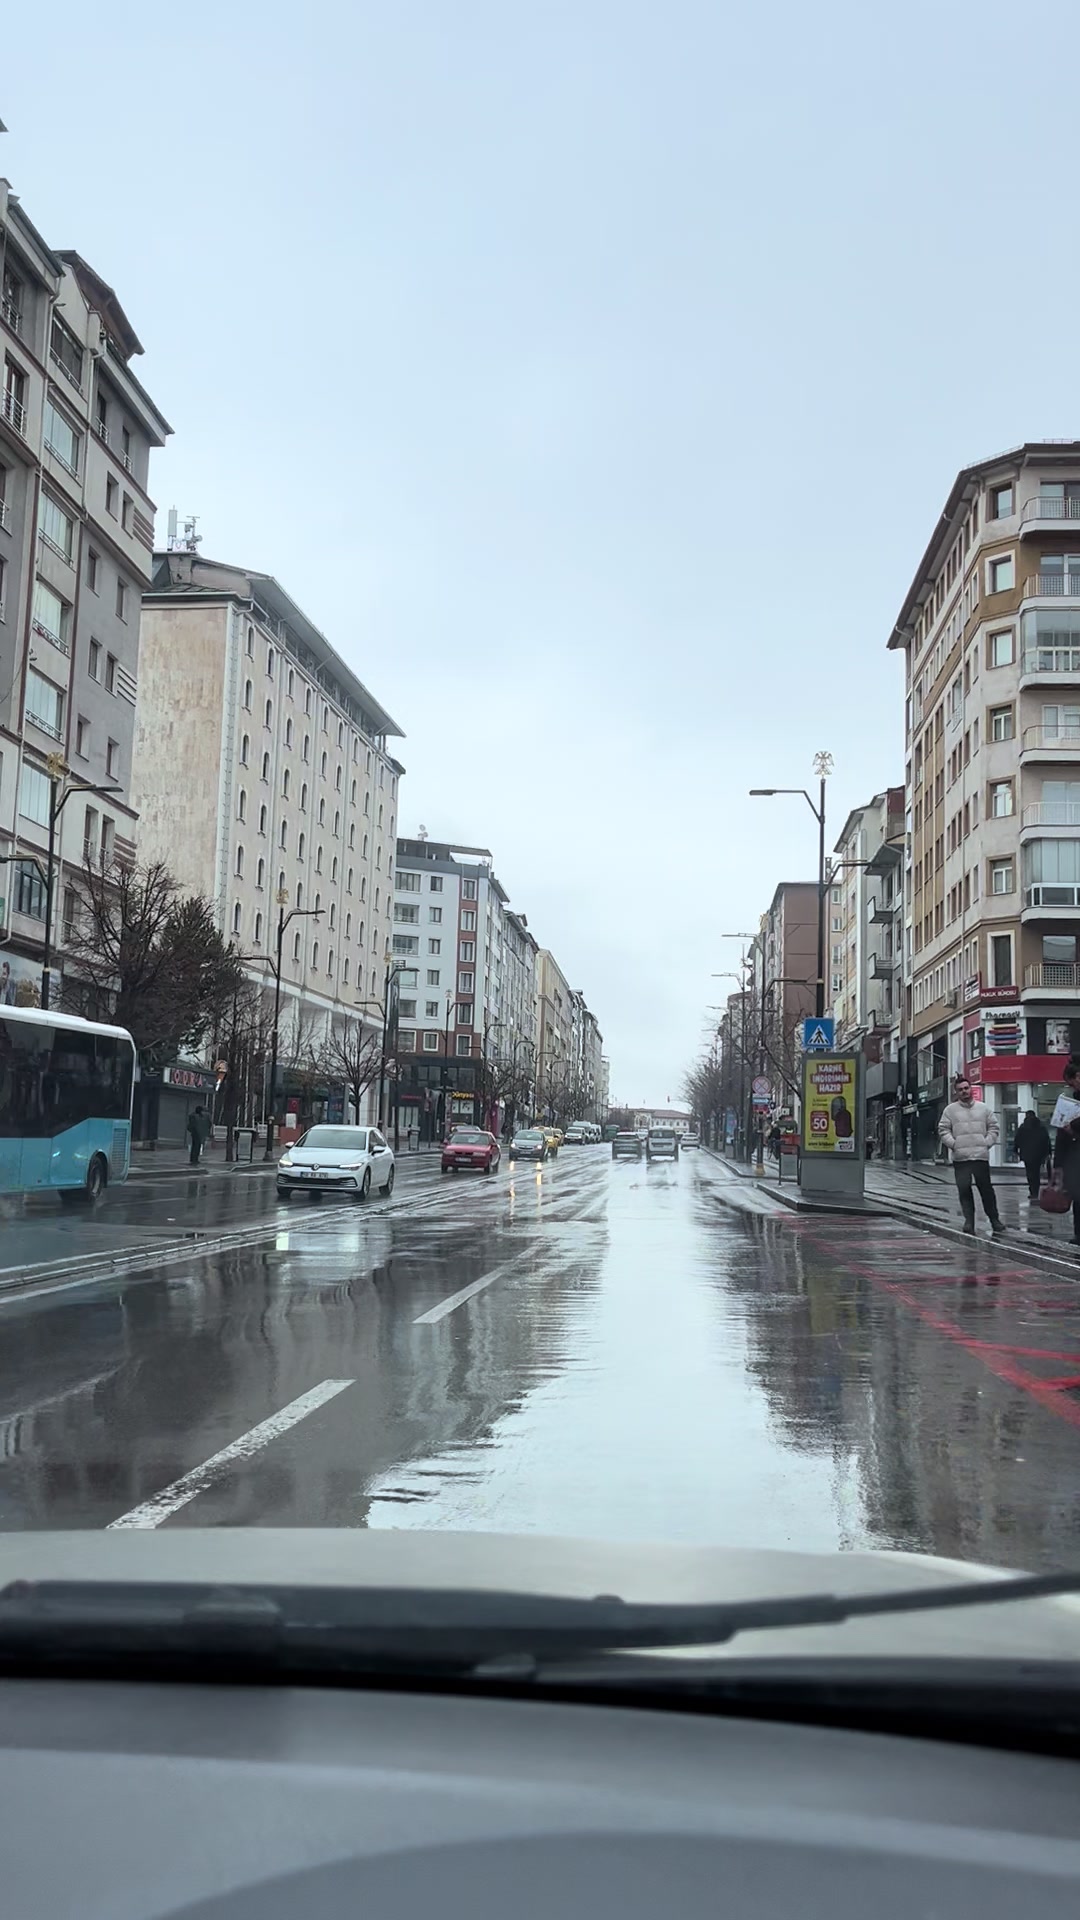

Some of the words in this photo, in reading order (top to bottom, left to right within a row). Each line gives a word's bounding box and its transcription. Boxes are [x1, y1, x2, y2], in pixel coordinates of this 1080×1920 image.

[985, 1011, 1020, 1019] Pharmacy
[818, 1064, 843, 1072] KARNE
[819, 1083, 841, 1092] HAZIR
